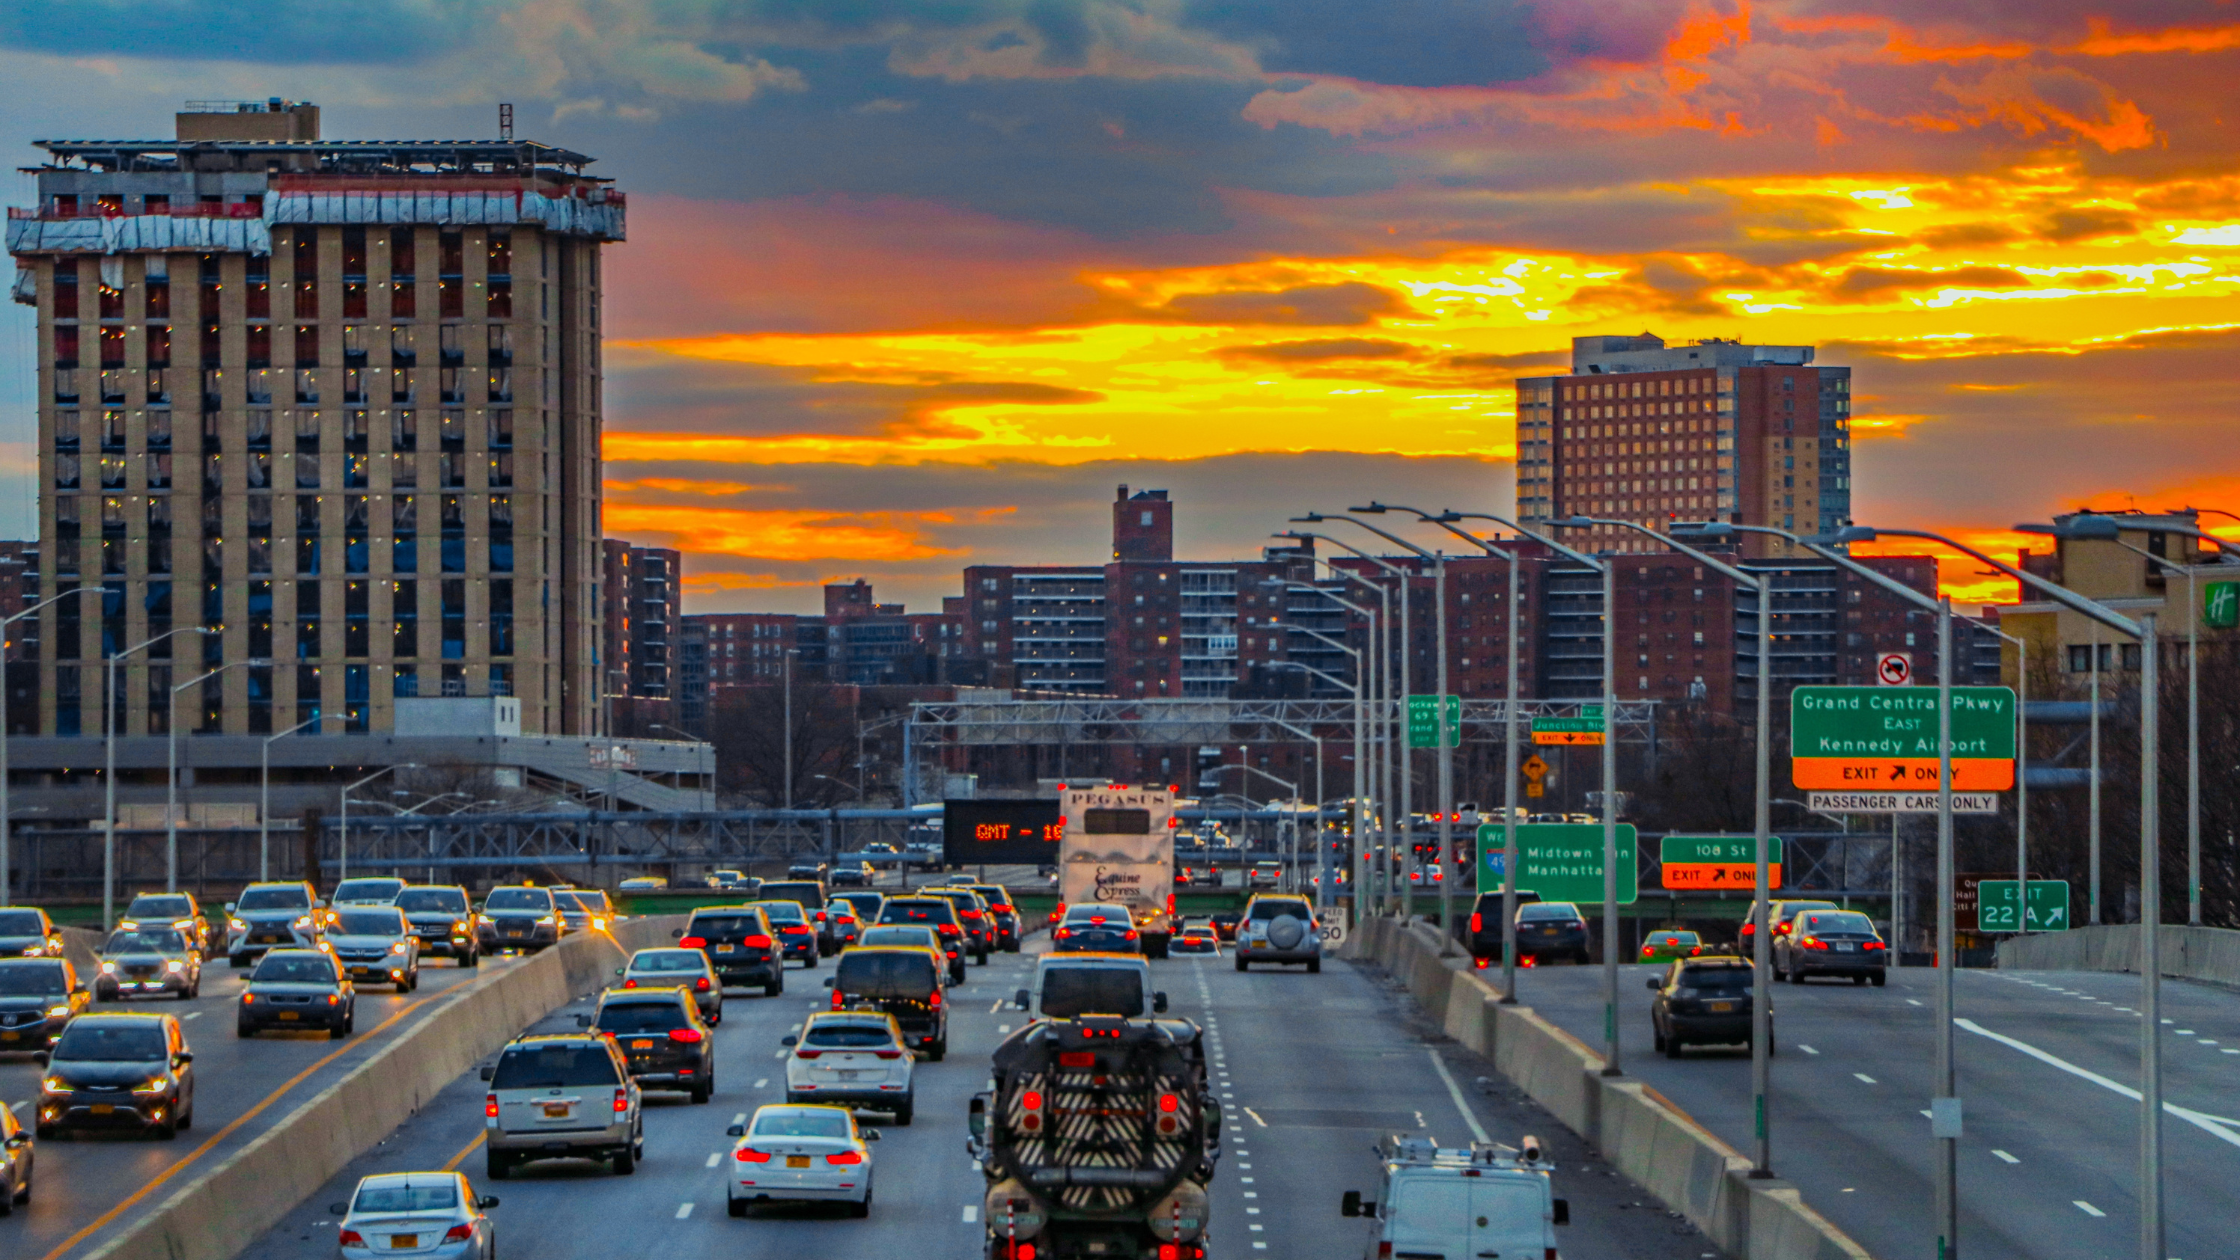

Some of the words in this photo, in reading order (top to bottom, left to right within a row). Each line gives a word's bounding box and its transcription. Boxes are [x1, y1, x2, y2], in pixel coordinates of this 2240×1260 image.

[1803, 695, 1860, 710] Grand
[1870, 695, 1936, 710] Centra
[1953, 695, 2003, 713] Pkwy
[1884, 717, 1922, 730] EAST
[1820, 737, 1902, 754] Kennedy
[1843, 767, 1878, 780] EXIT
[1915, 768, 1960, 780] ONY
[1072, 794, 1164, 805] PEGASUS
[1813, 796, 1897, 809] PASSENGER
[1953, 797, 1991, 809] ONLY
[1528, 848, 1592, 859] Midtown
[1697, 845, 1721, 856] 108
[1731, 845, 1747, 856] St
[1528, 865, 1605, 876] Manhatta
[1672, 870, 1701, 881] EXIT
[1733, 871, 1757, 881] ONL
[1956, 891, 1975, 899] Hall
[1985, 906, 2014, 923] 22
[1321, 926, 1342, 940] 50
